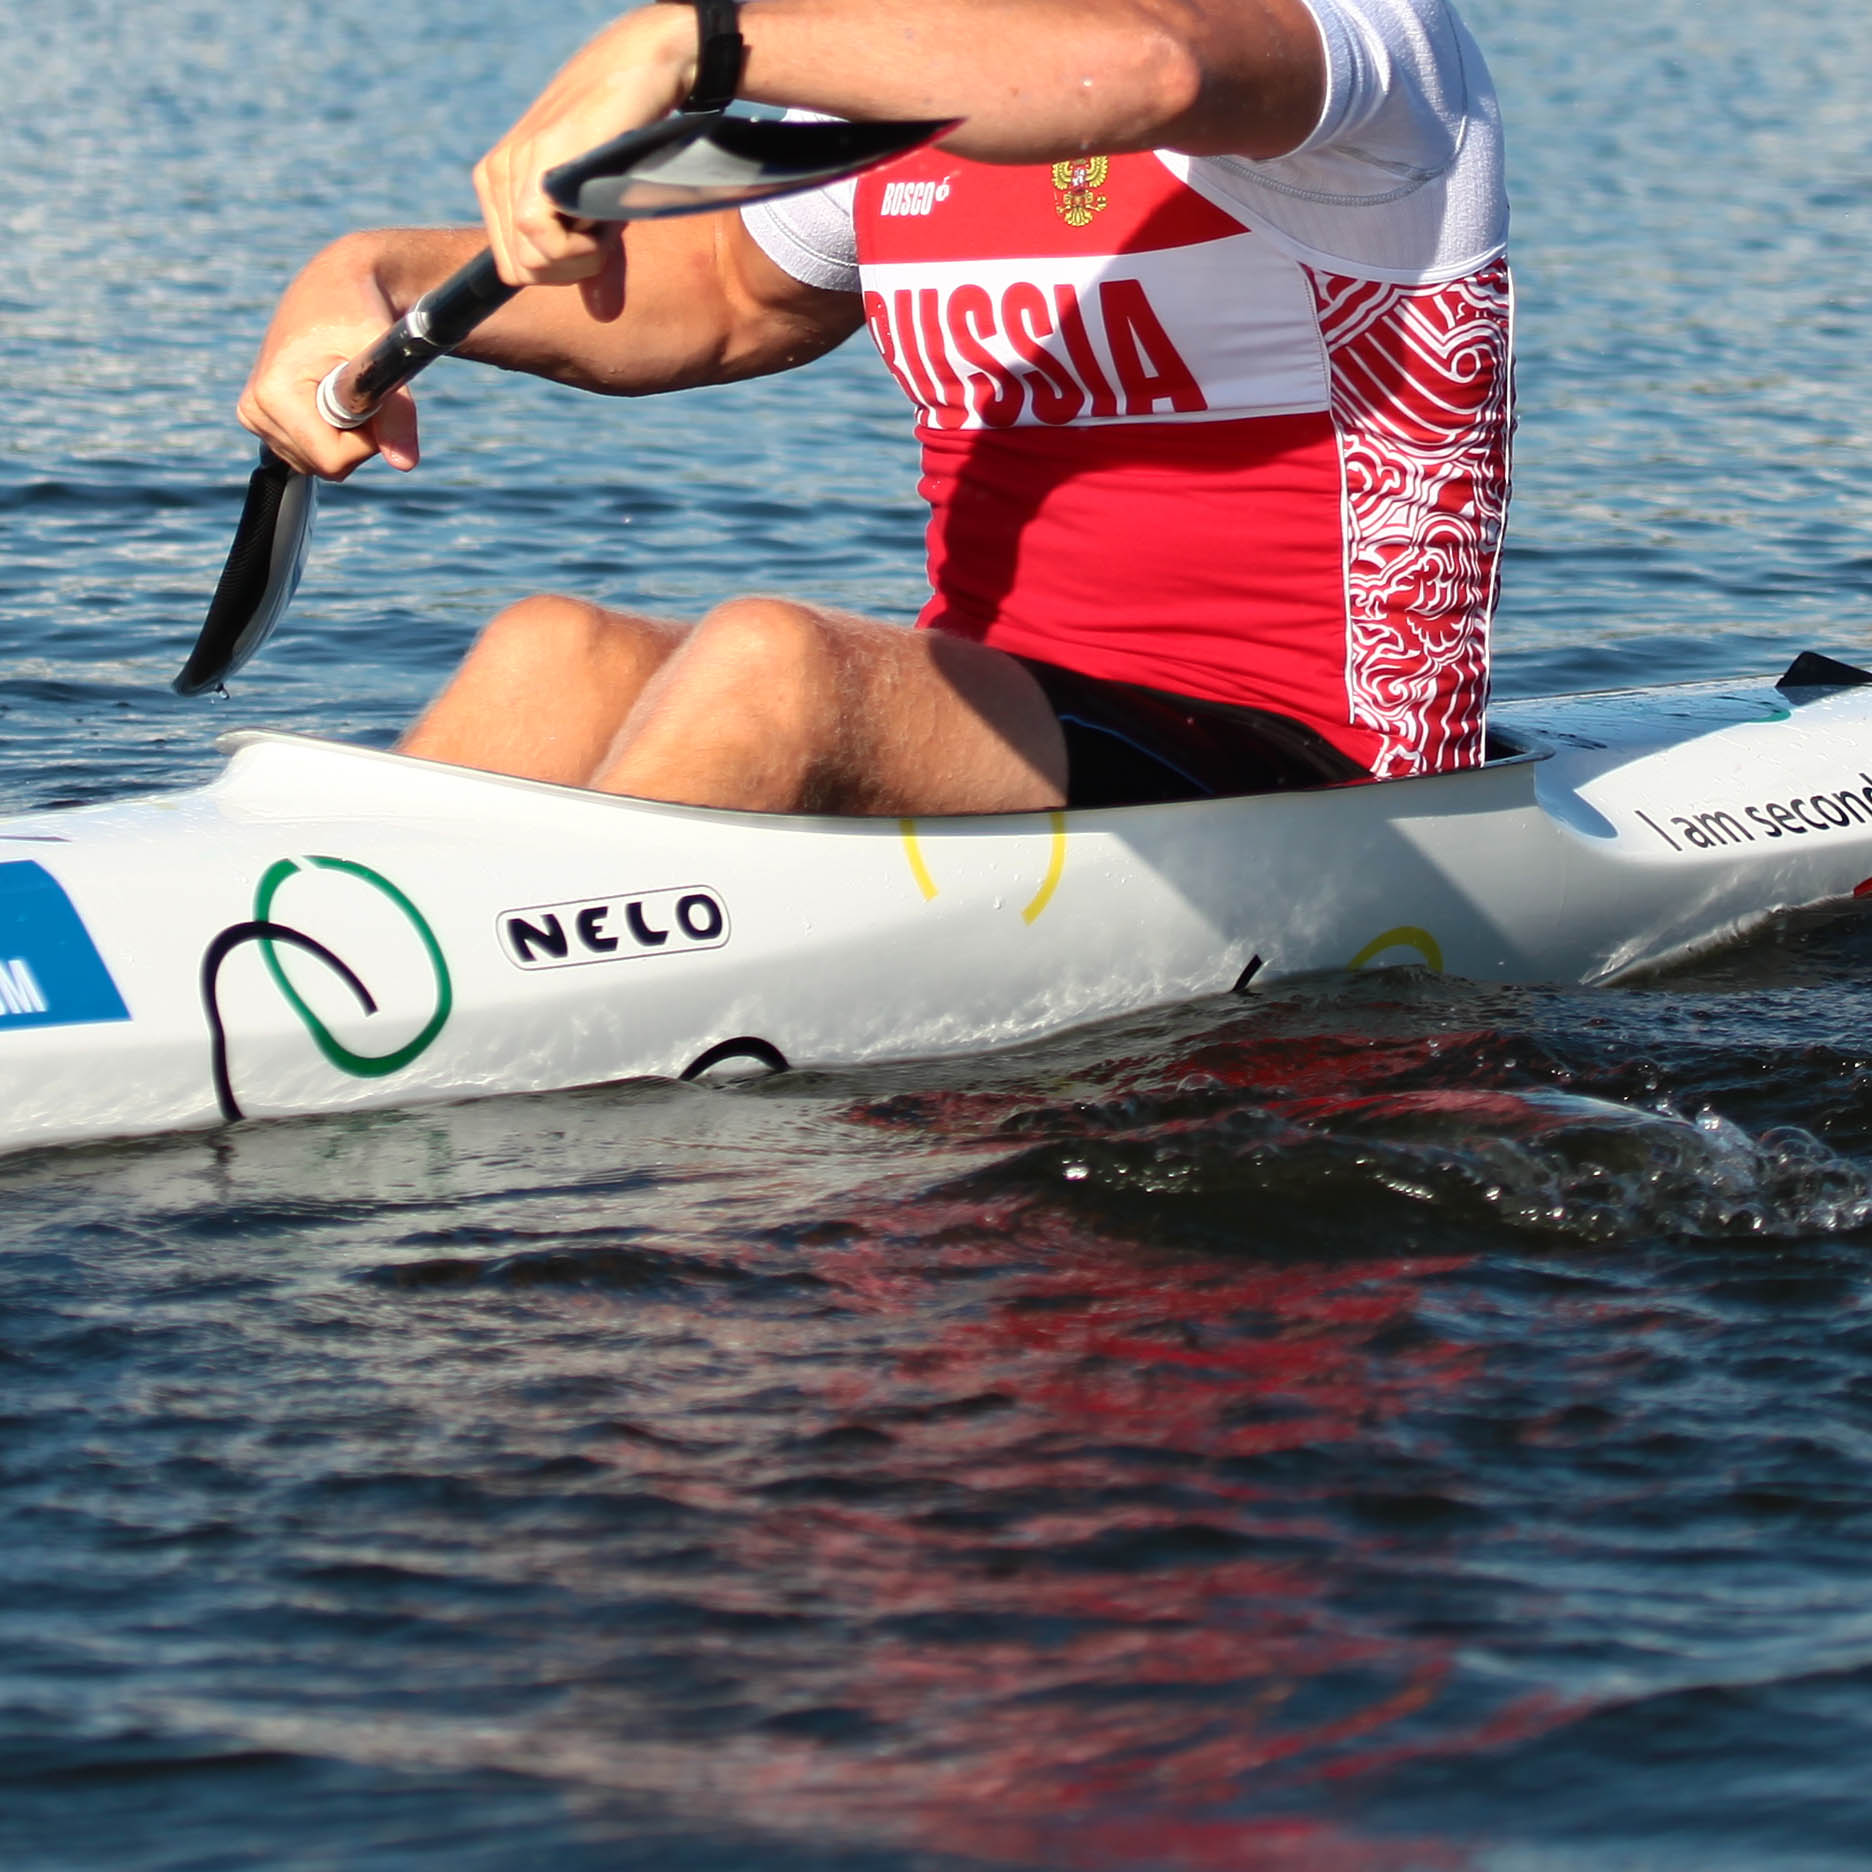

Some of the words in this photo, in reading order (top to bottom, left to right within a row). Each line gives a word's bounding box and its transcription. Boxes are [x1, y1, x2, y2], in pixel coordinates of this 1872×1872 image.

[880, 181, 936, 216] BOSCO
[1634, 810, 1682, 851] I
[1670, 811, 1755, 849] am
[506, 893, 724, 963] NELO
